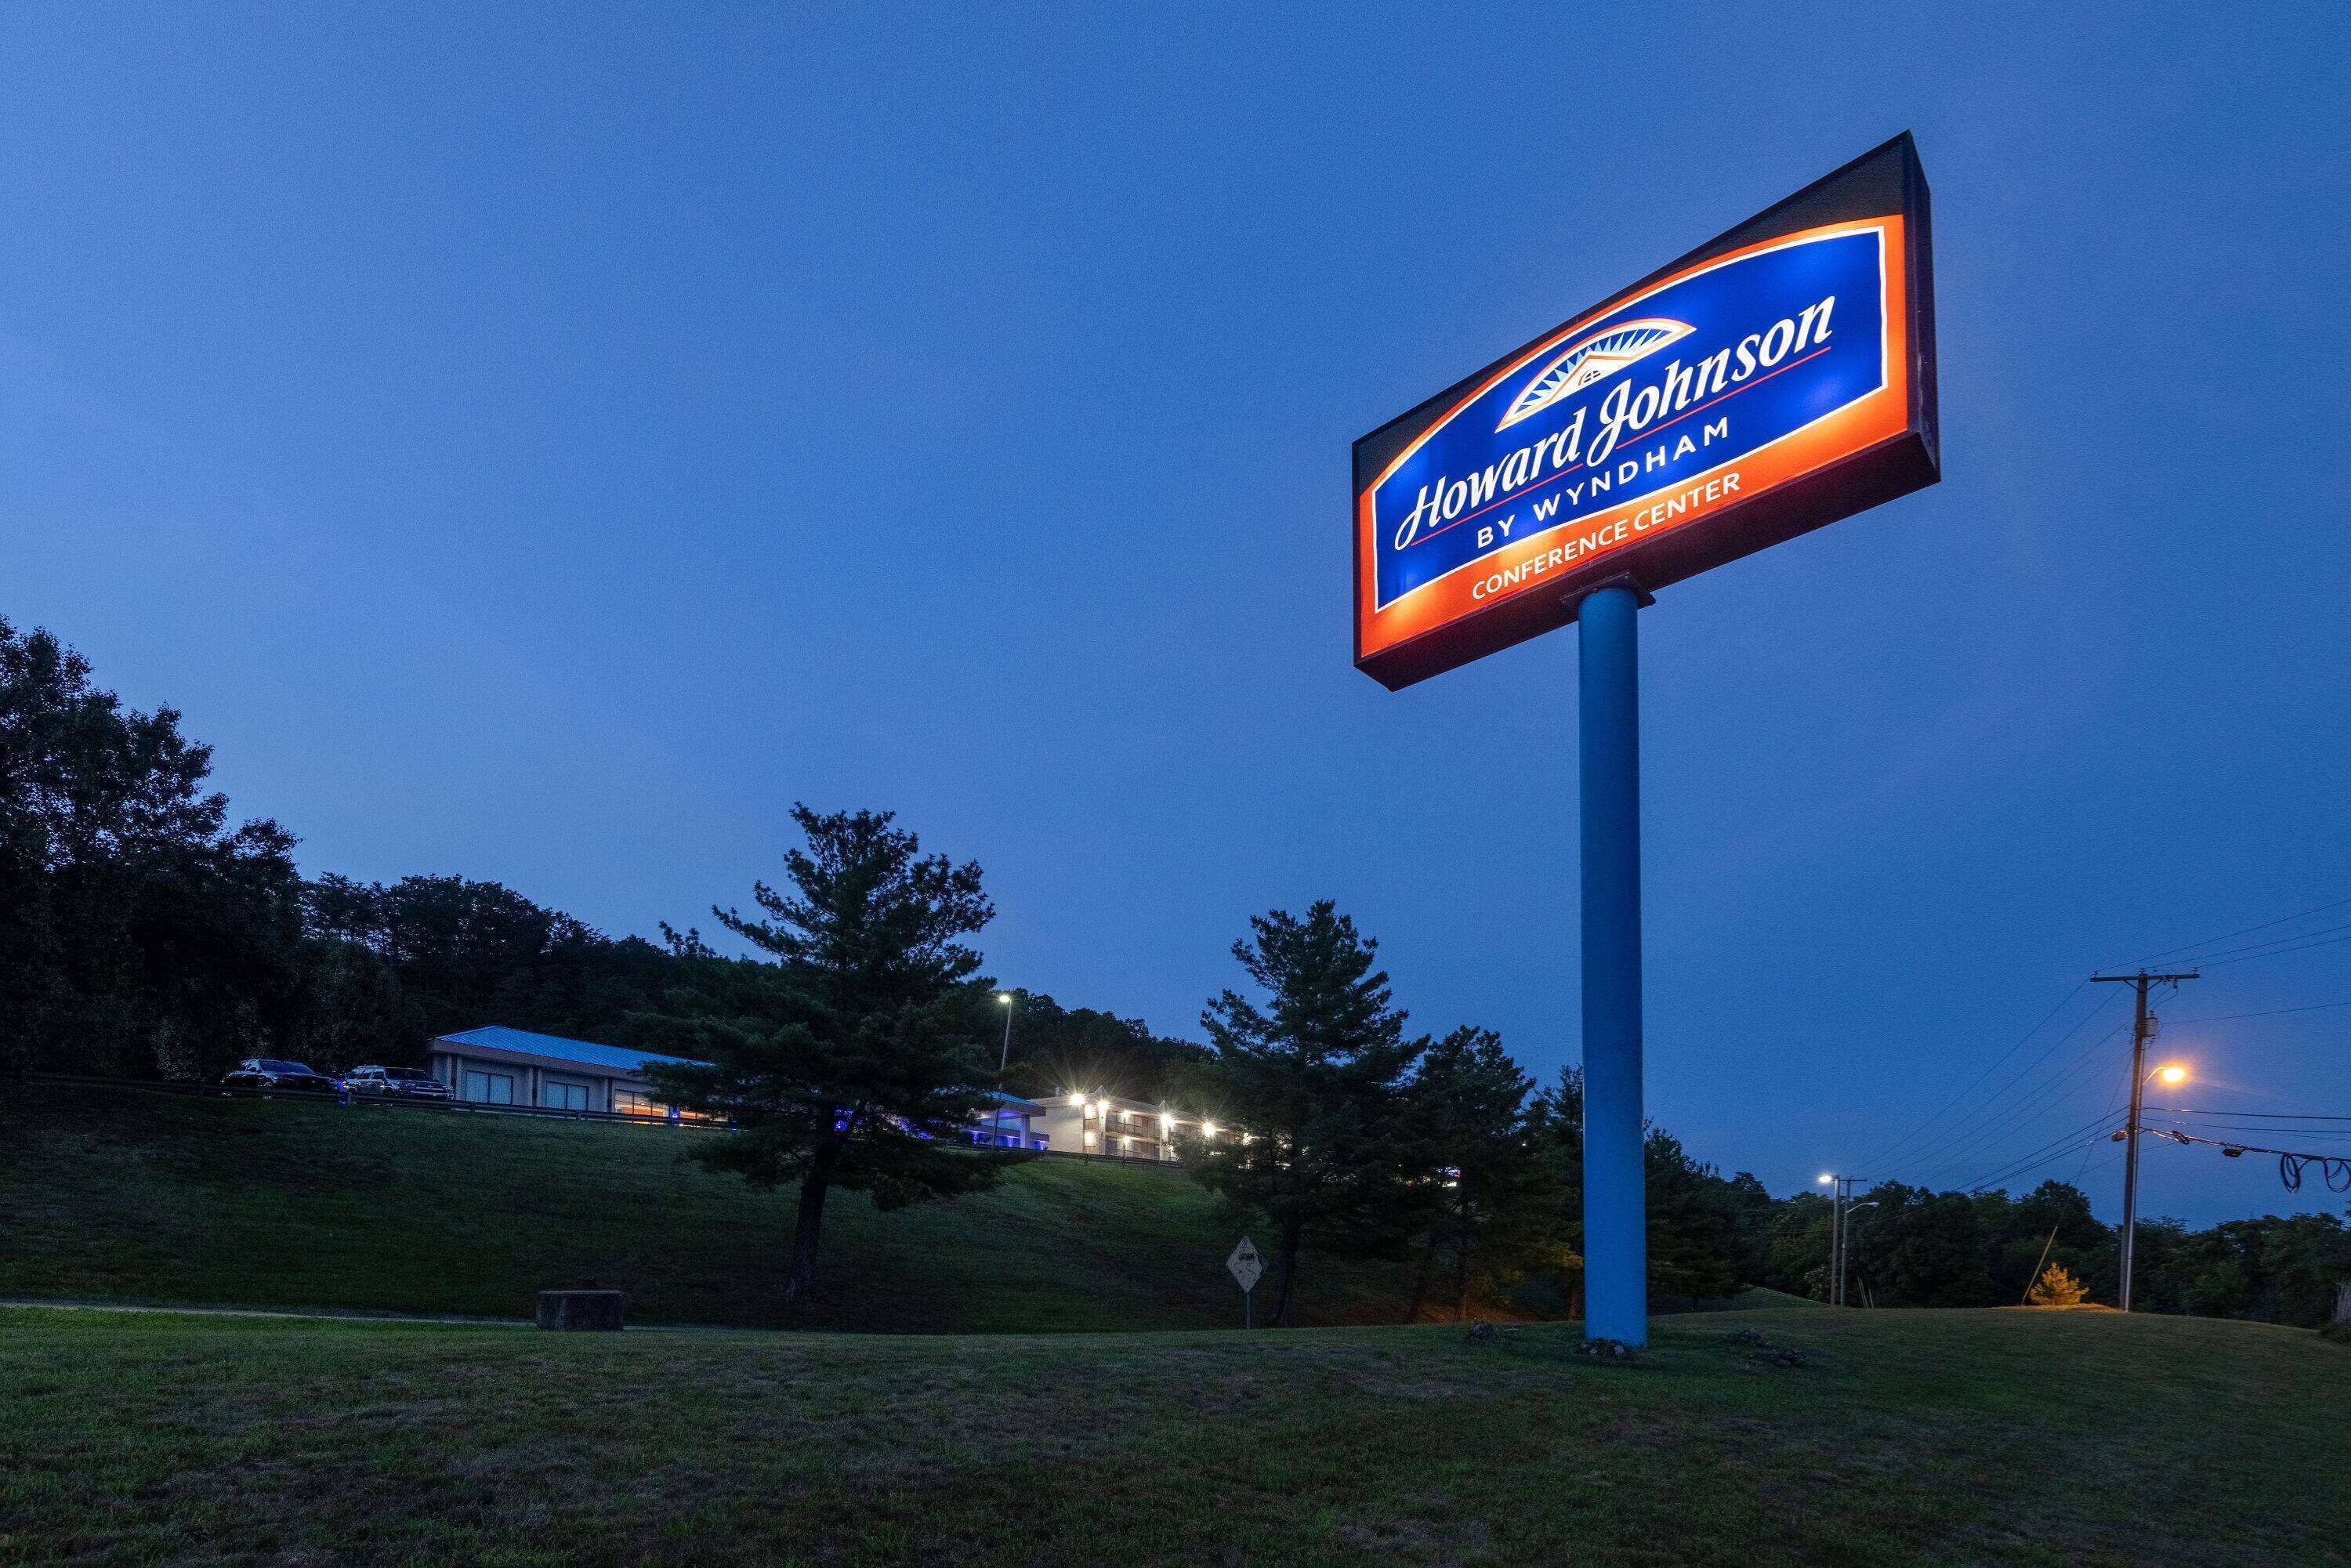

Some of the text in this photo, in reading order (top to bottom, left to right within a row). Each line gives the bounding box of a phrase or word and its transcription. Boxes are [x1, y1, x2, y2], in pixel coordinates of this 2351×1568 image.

[1395, 295, 1836, 550] Howard Johnson
[1477, 417, 1729, 548] BY WYNDHAM
[1472, 472, 1741, 599] CONFERENCE CENTER
